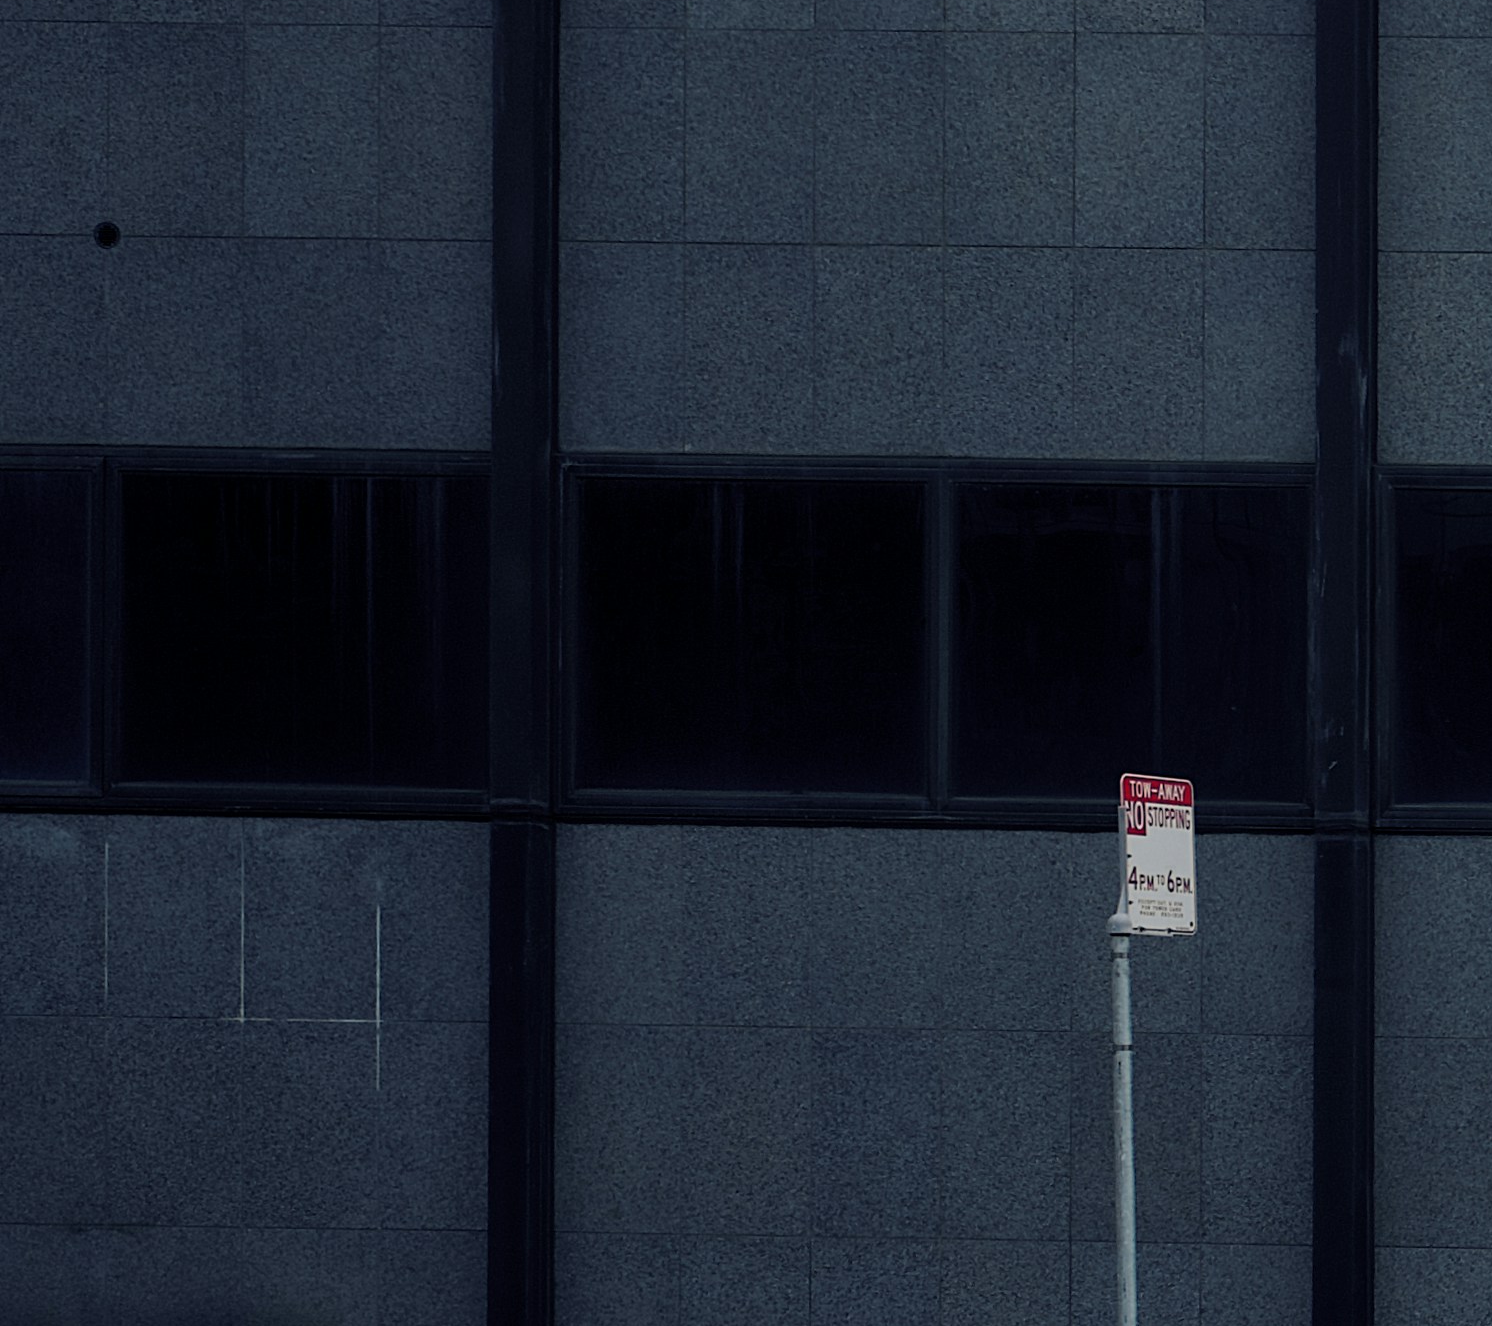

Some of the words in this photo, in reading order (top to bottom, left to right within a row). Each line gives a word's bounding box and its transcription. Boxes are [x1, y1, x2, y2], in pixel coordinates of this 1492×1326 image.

[1129, 780, 1185, 802] TOW-AWAY
[1125, 800, 1145, 830] NO
[1148, 806, 1190, 830] STOPPING
